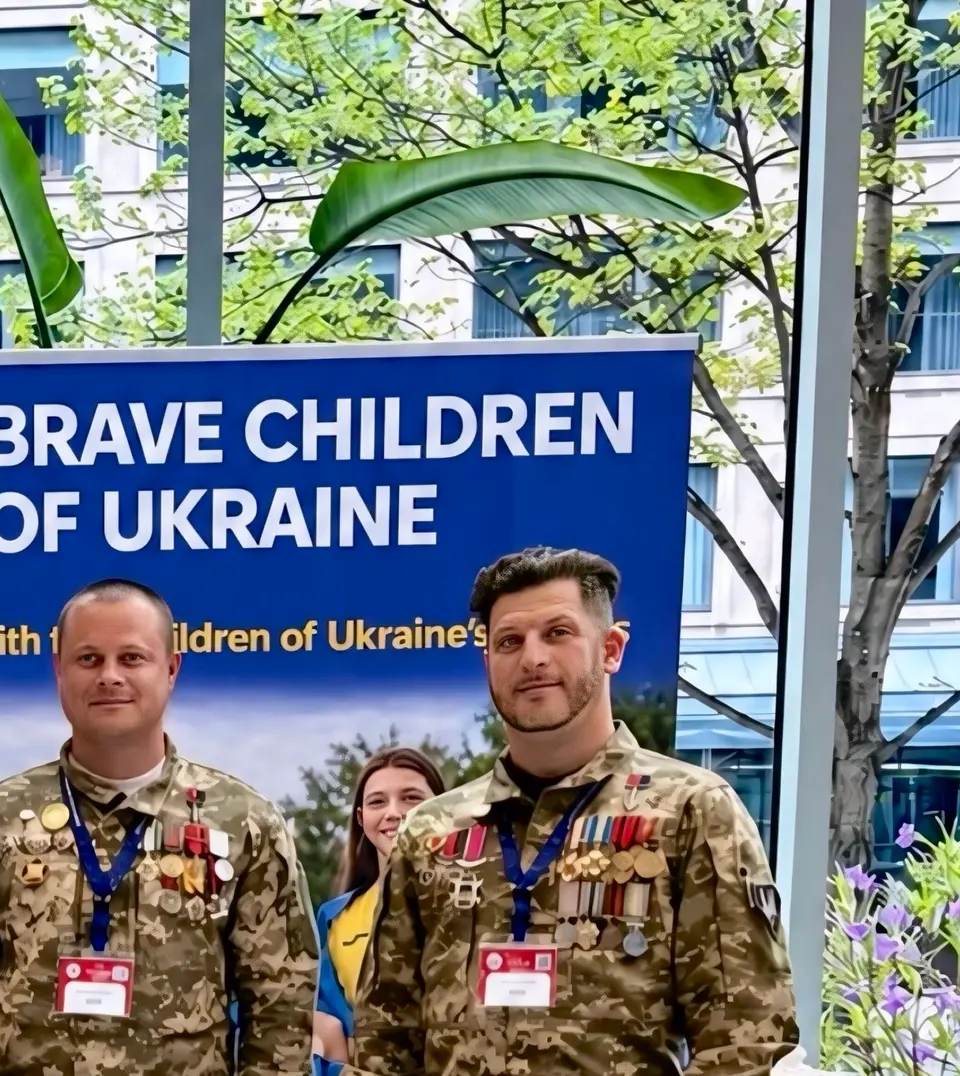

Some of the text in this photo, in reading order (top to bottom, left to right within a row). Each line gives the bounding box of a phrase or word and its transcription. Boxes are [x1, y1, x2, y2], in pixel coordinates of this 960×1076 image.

[244, 390, 635, 463] CHILDREN
[103, 484, 439, 552] UKRAINE
[172, 621, 271, 653] ildren
[280, 619, 318, 652] of
